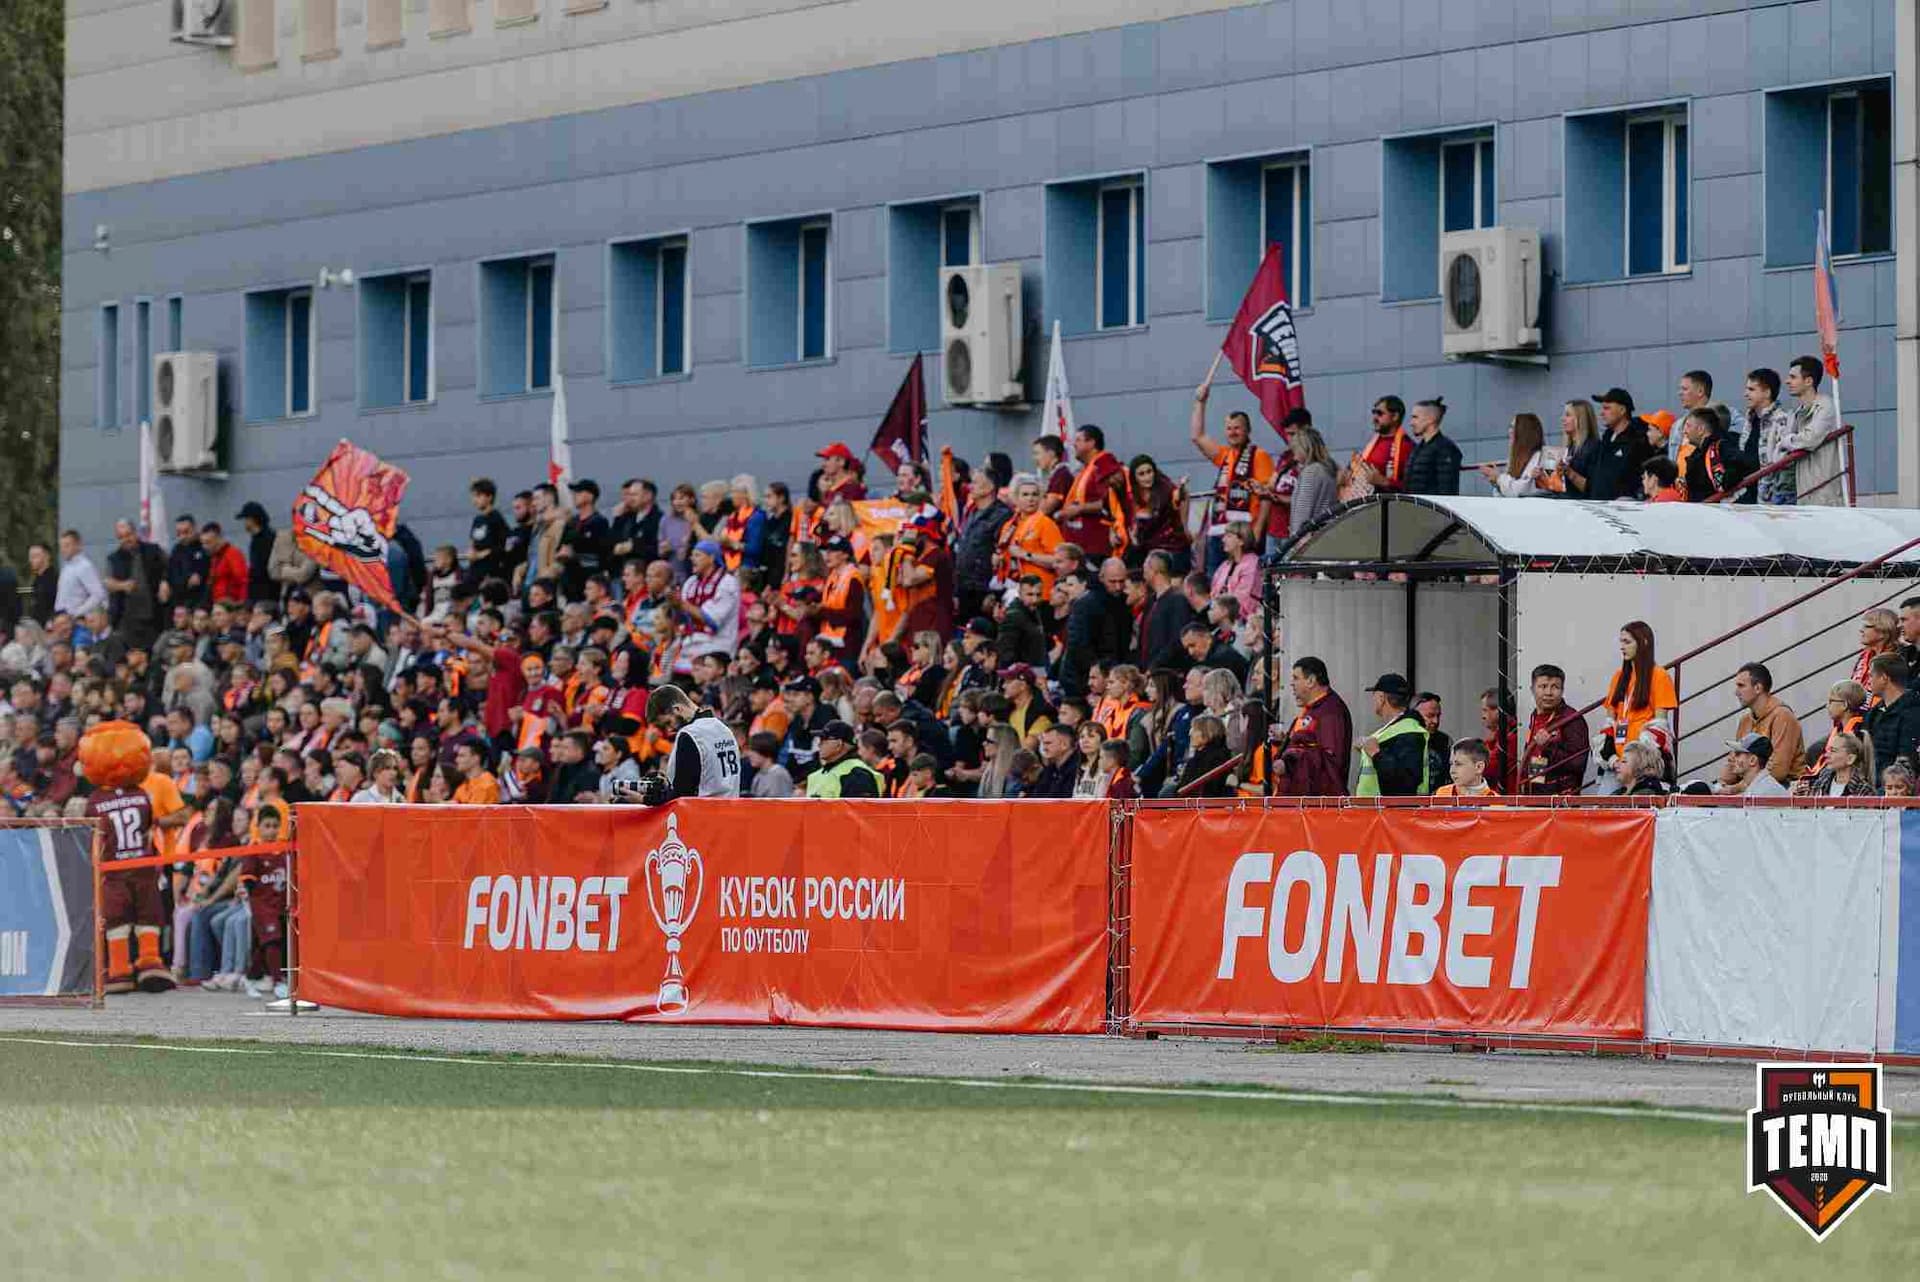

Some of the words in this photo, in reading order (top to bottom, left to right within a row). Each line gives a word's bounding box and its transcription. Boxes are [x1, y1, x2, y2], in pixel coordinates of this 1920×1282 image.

[108, 807, 143, 850] 12
[463, 874, 630, 951] FONBET
[719, 876, 797, 919] КУБОК
[804, 876, 905, 921] РОССИИ
[1216, 850, 1563, 990] FONBET
[721, 927, 741, 952] ПО
[744, 927, 810, 953] ФУТБОЛУ
